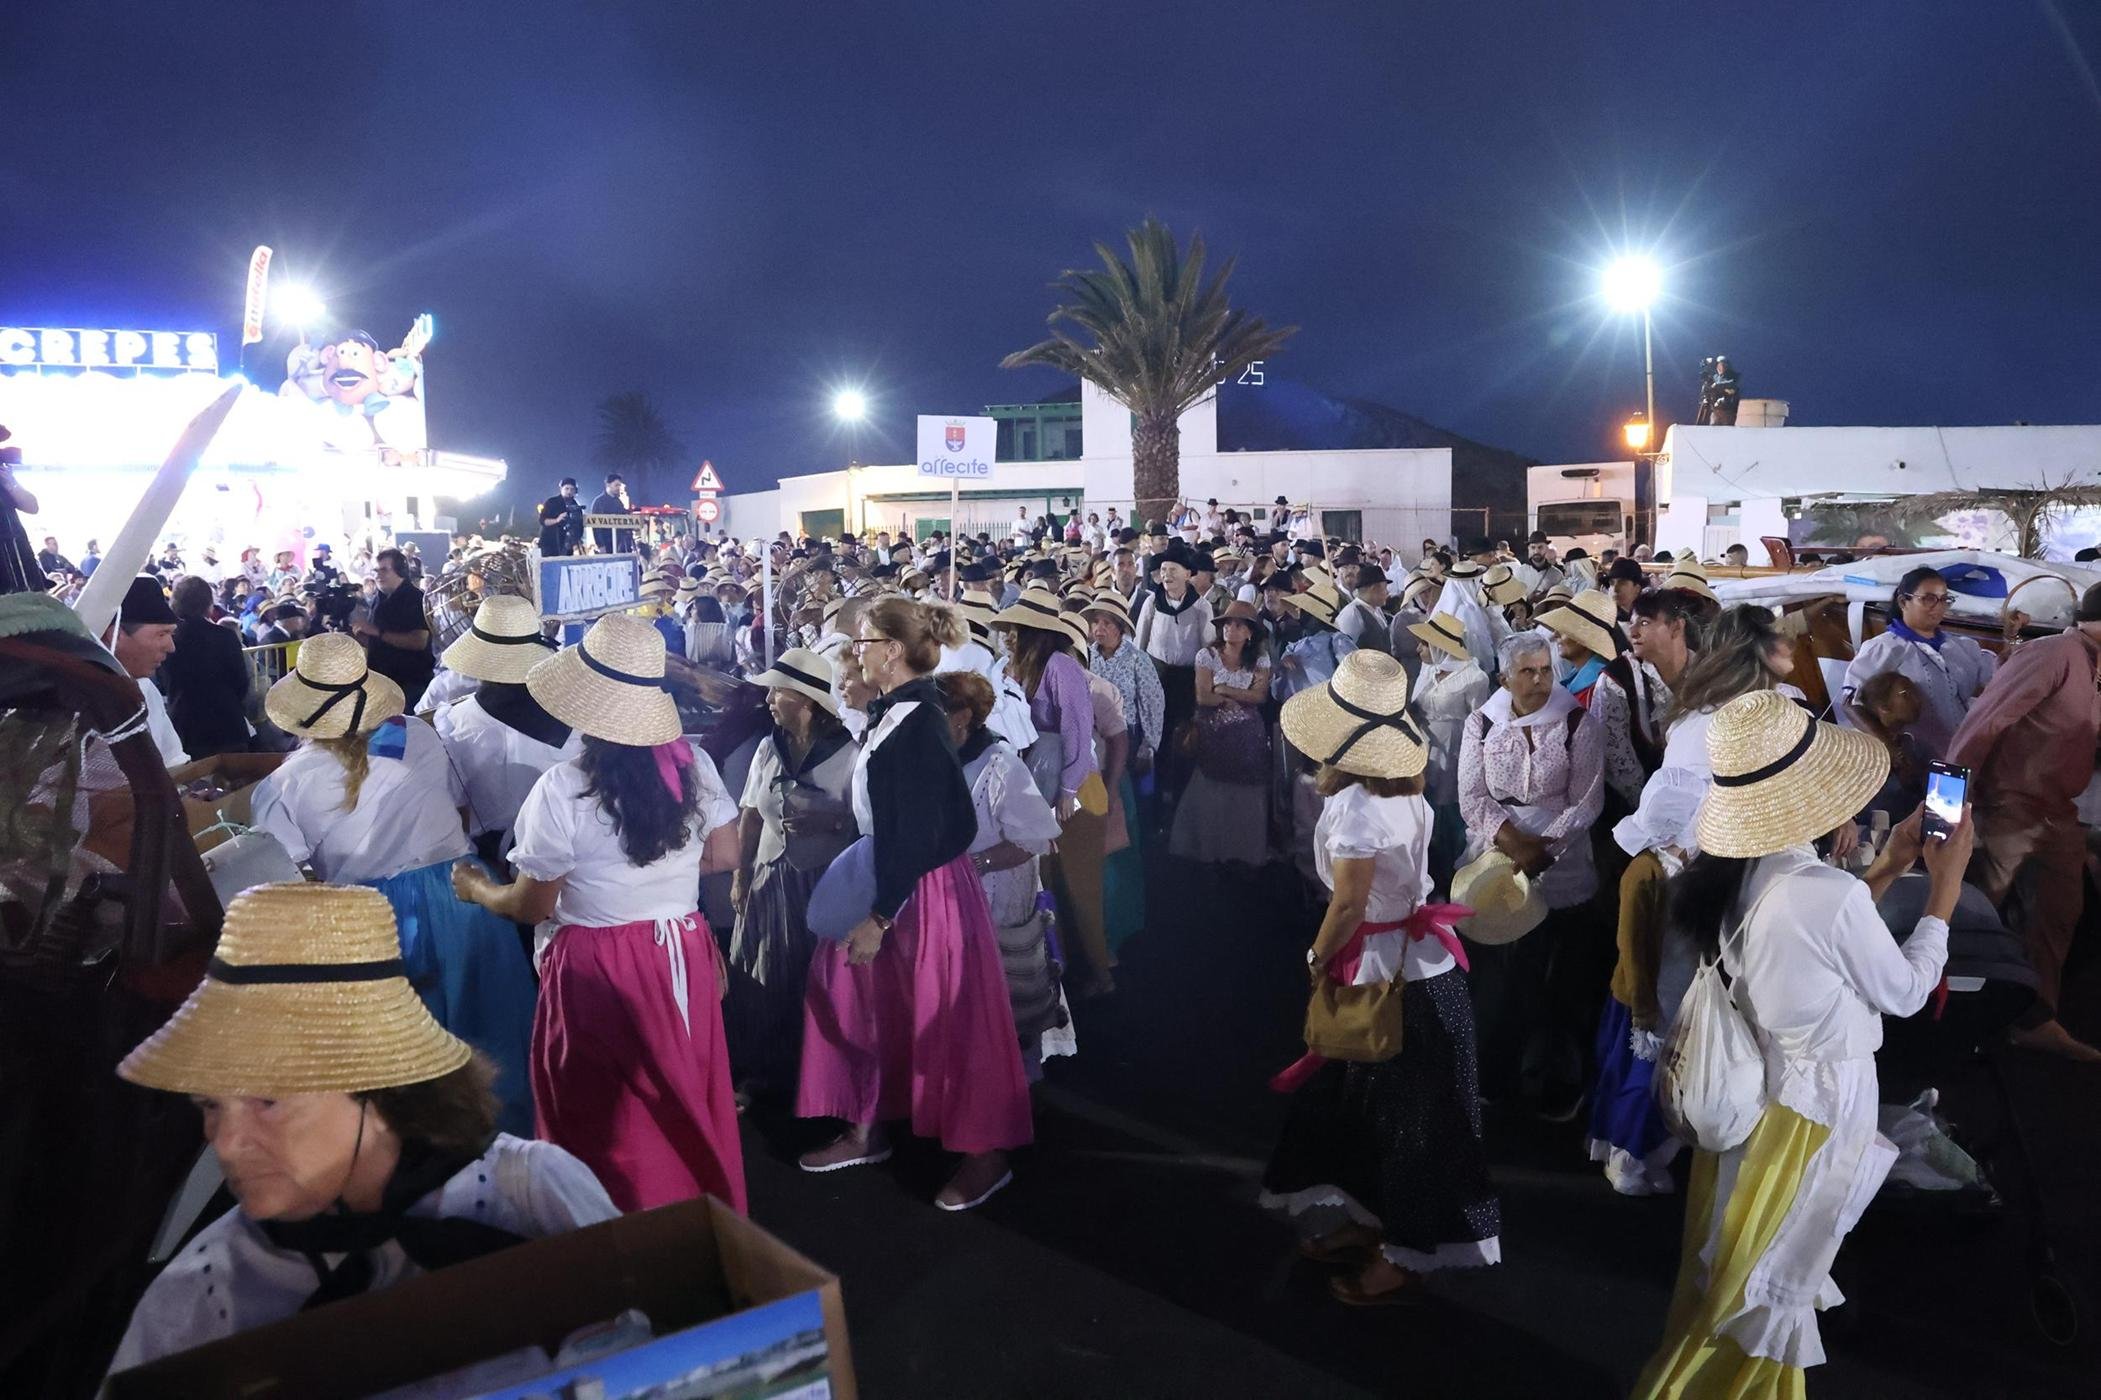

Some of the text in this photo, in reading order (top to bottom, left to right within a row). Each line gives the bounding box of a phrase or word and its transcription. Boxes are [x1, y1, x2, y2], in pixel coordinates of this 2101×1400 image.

[0, 329, 217, 366] CREPES
[1237, 361, 1264, 385] 25
[921, 458, 989, 475] arrecife
